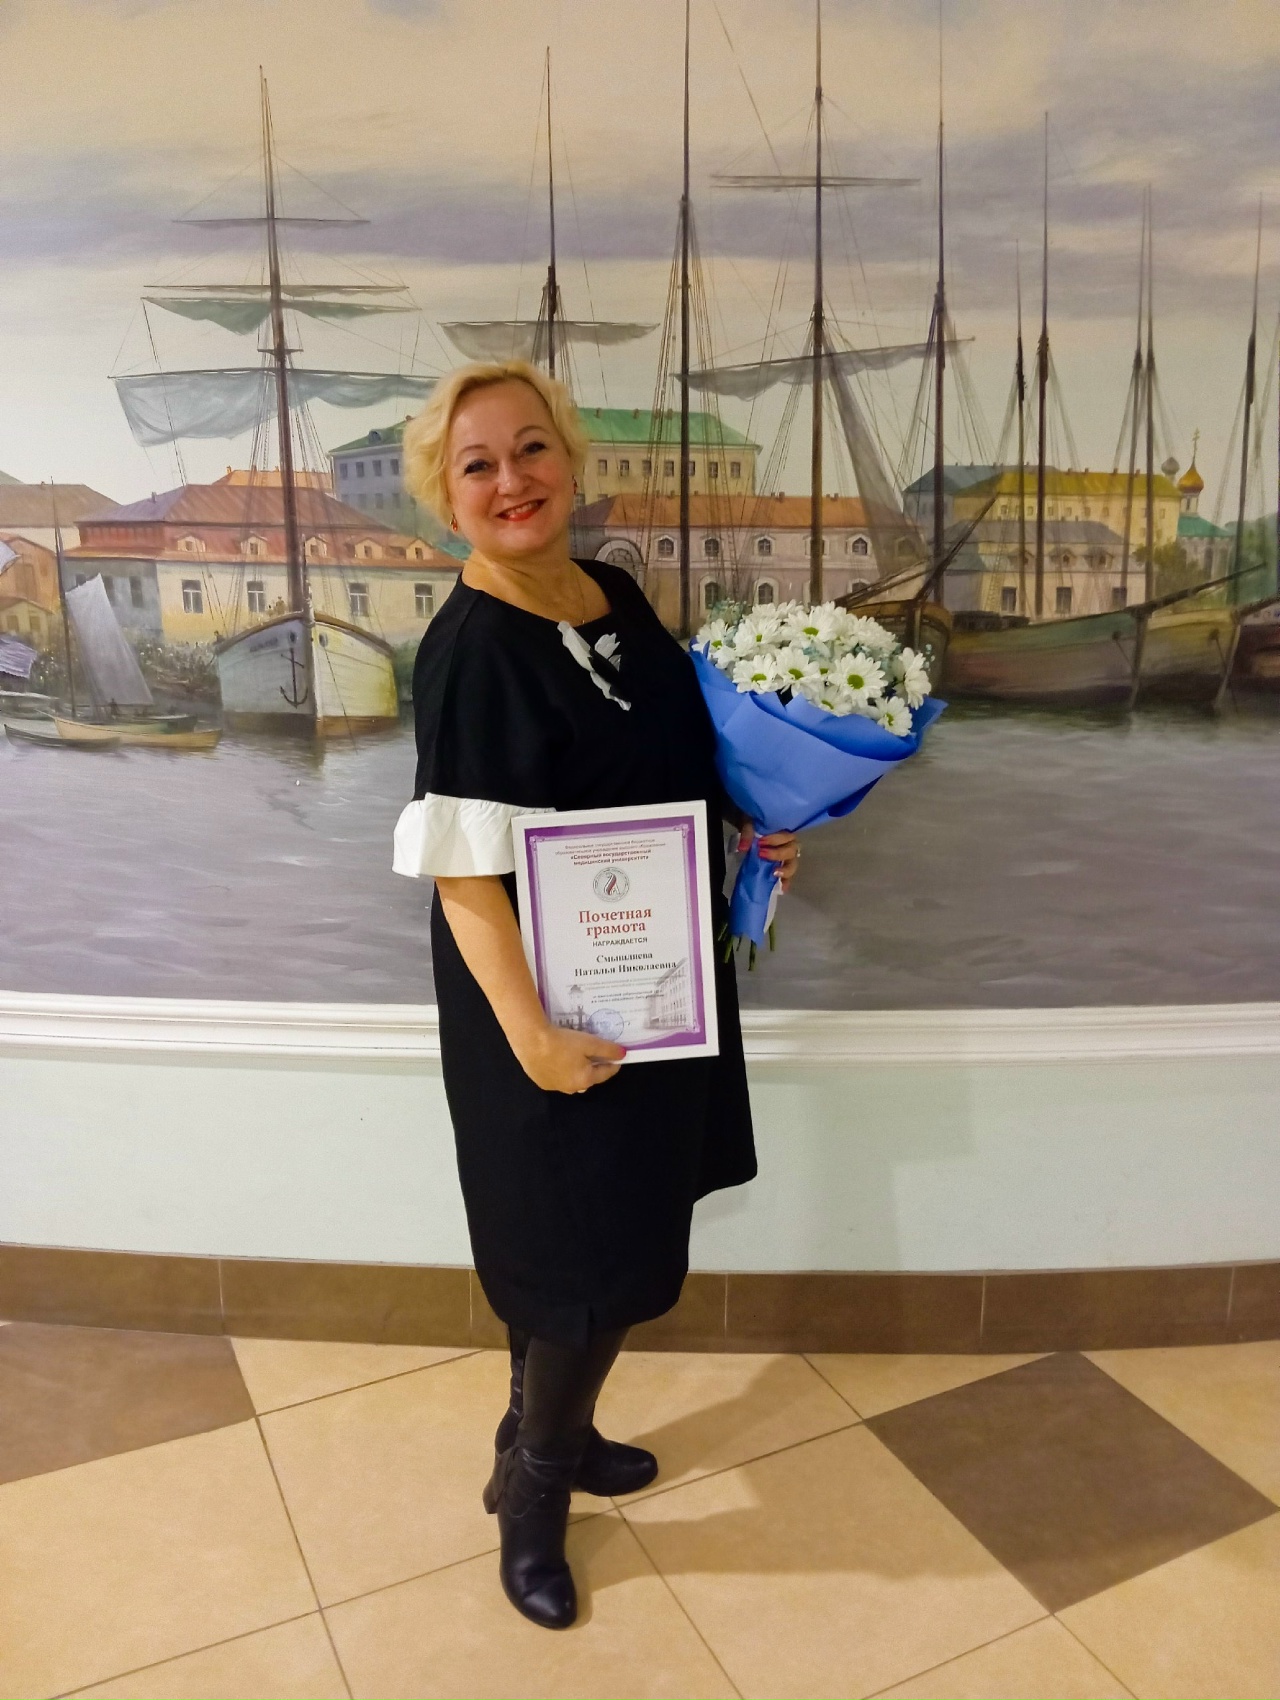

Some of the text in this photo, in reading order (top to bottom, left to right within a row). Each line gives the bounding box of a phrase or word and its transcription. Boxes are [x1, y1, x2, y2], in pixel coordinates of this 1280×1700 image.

[579, 907, 652, 924] Почетная
[586, 922, 646, 939] грамота
[592, 937, 648, 947] НАГРАЖДАЕТСЯ
[574, 961, 677, 976] Наталья Николаевна
